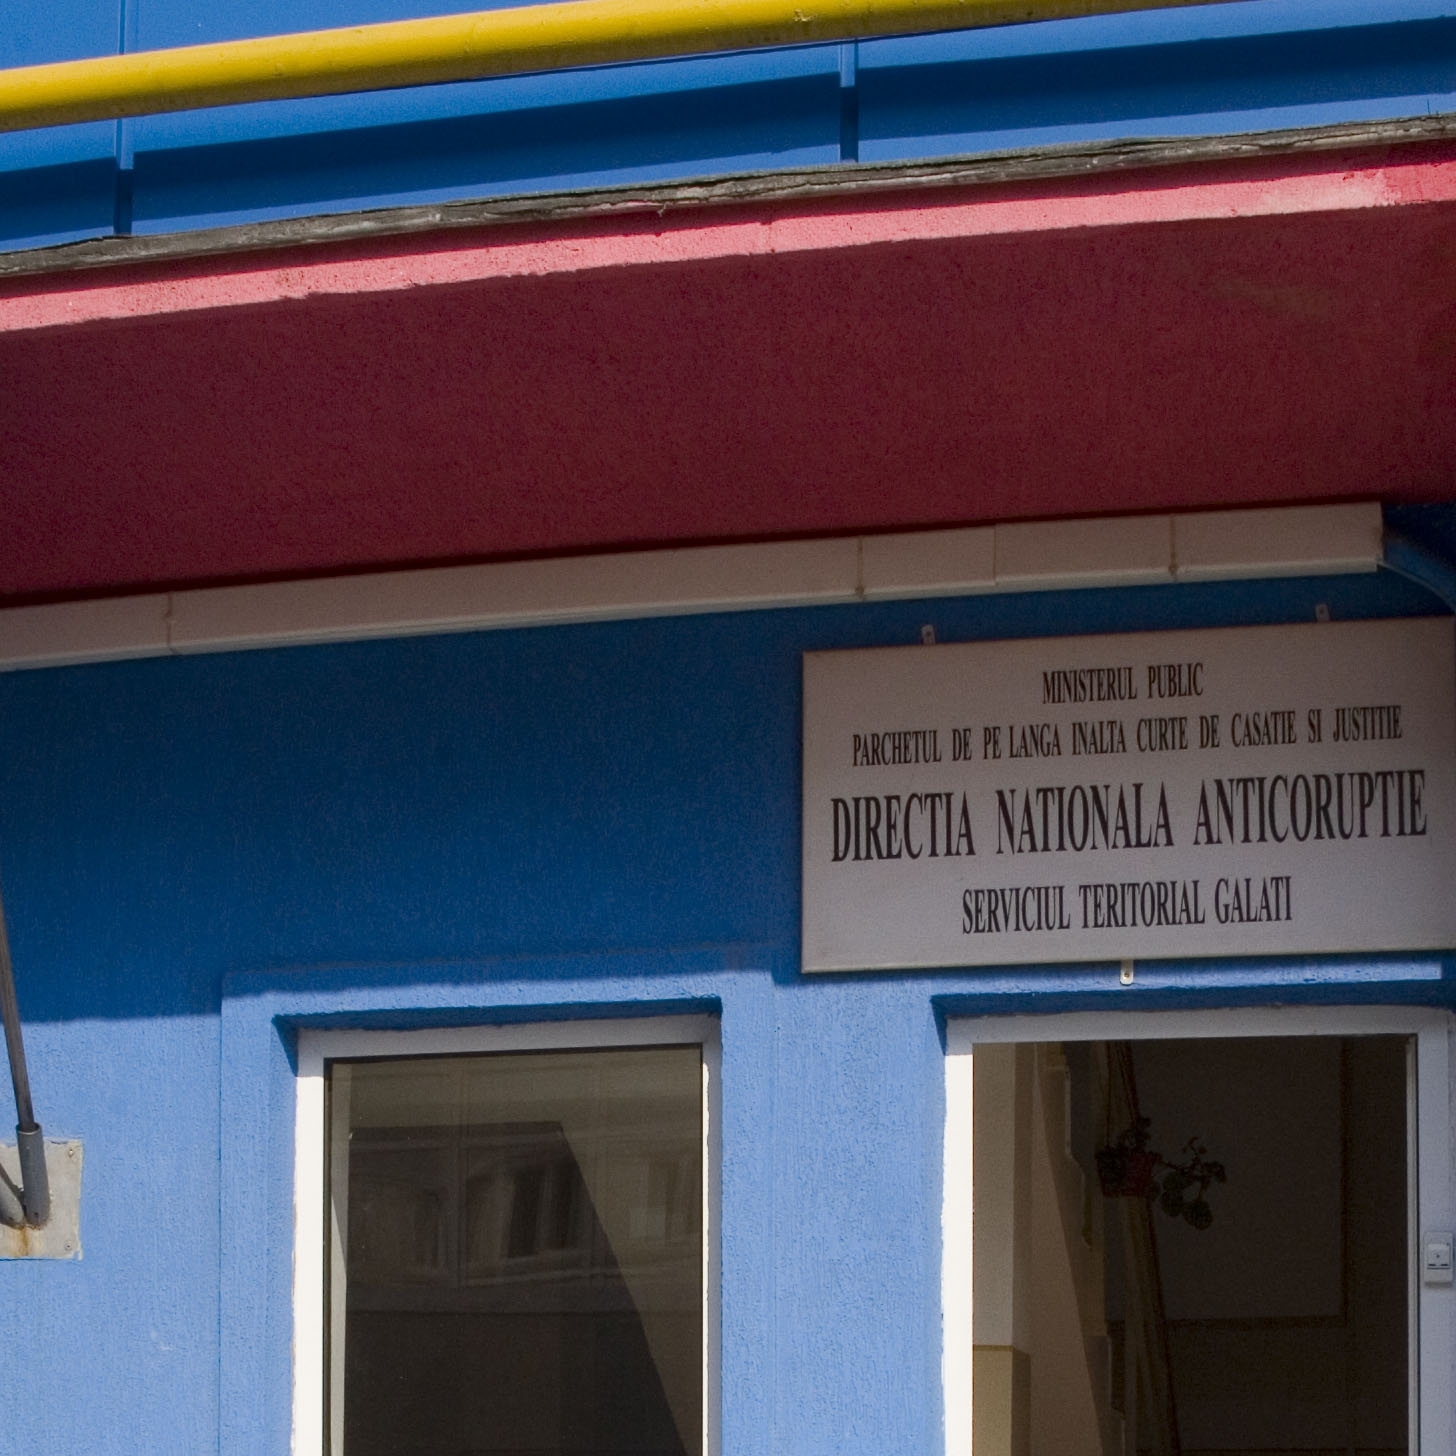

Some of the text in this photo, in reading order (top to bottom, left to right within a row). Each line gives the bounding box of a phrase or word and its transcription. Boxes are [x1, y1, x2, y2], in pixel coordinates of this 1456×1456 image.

[1043, 662, 1203, 704] MINISTERUL PUBLIC
[853, 705, 1402, 766] PARCHETUL DE PE LANGA INALTA CURTE DE CASATIE SI JUSTITIE
[831, 769, 1427, 862] DIRECTIA NATIONALA ANTICORUPTIE
[963, 876, 1292, 934] SERVICIUL TERITORIAL GALATI
